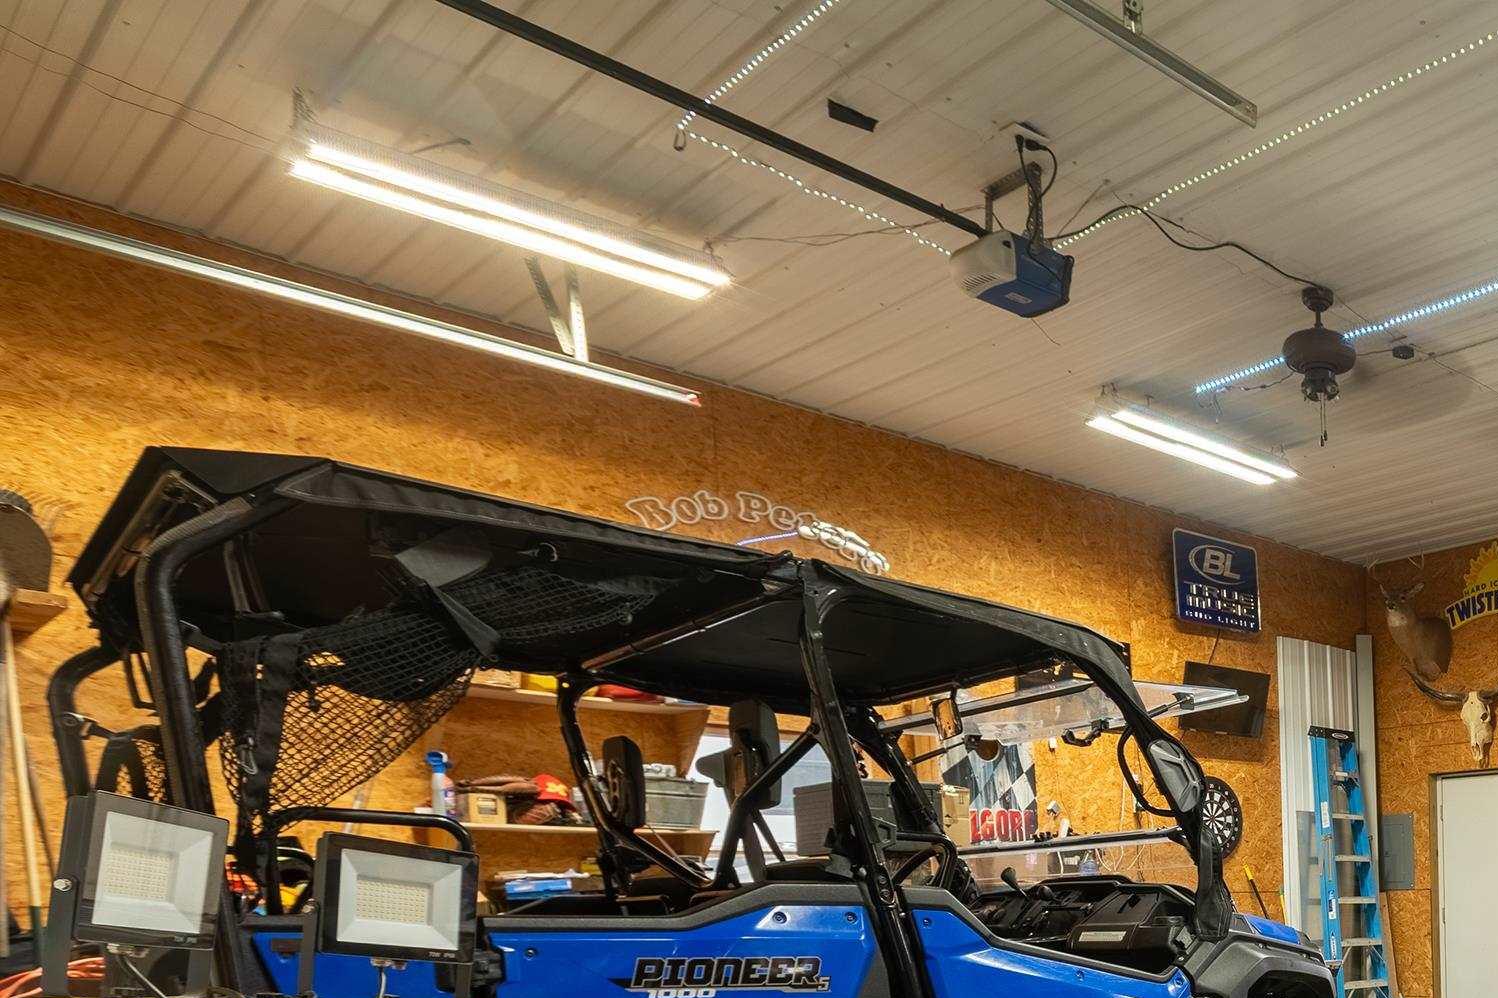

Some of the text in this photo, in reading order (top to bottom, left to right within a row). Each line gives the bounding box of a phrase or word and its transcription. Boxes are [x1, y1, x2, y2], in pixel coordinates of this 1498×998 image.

[1203, 548, 1240, 579] BL
[1464, 582, 1487, 595] HARD
[631, 956, 822, 988] PIONEER
